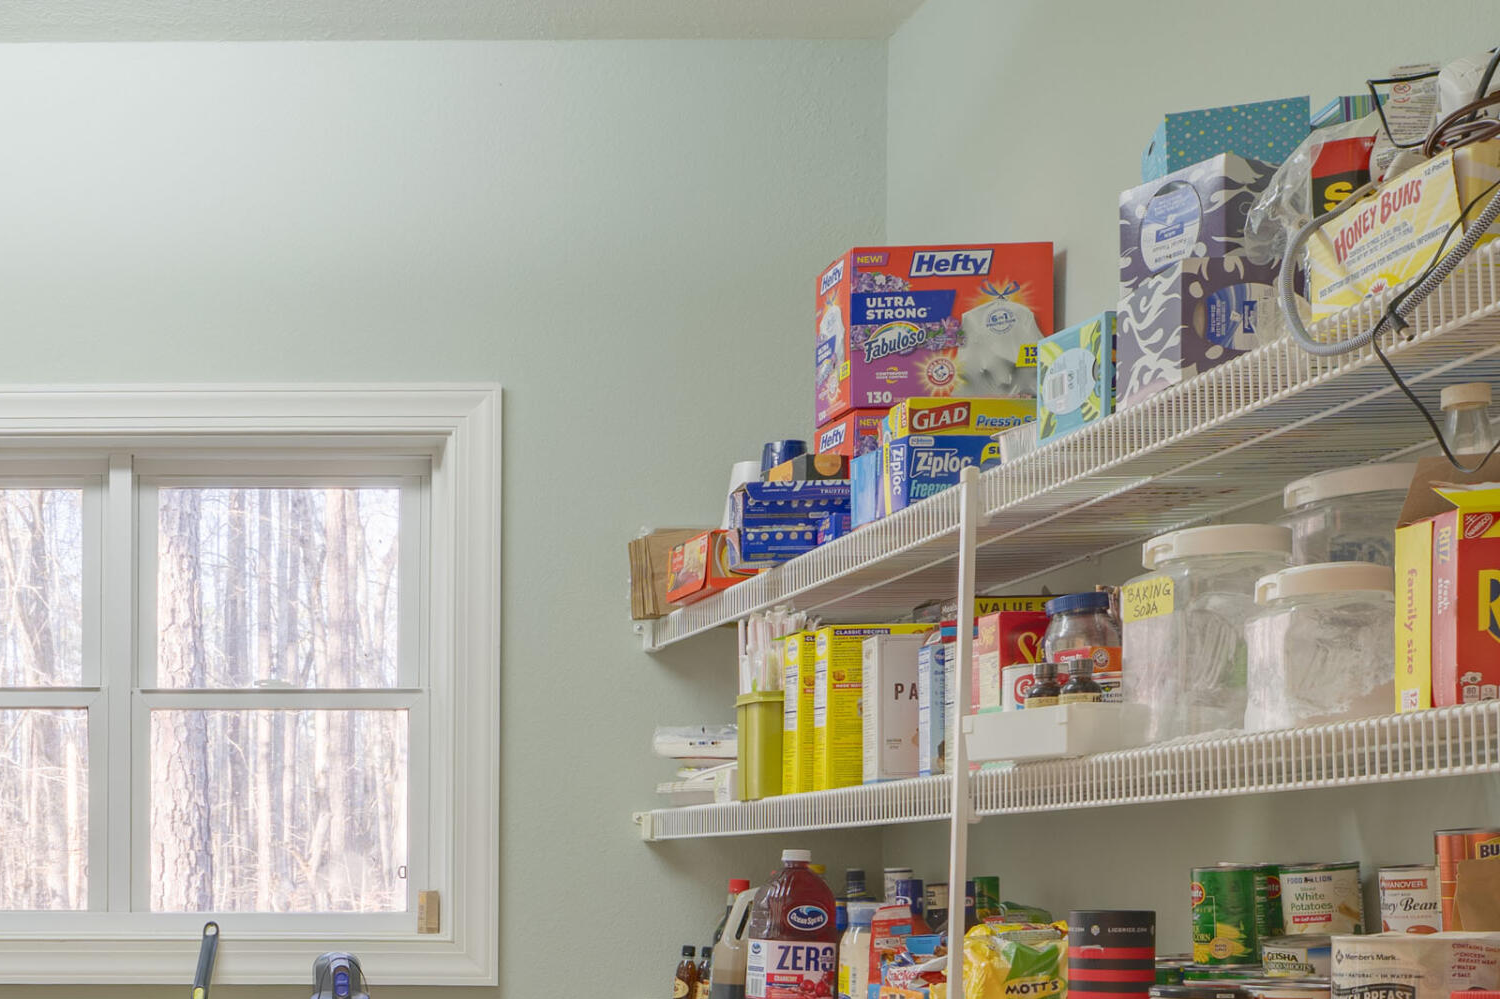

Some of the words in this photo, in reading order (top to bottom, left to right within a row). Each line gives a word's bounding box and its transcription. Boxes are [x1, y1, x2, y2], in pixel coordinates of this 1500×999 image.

[1334, 204, 1377, 265] HONEY
[1380, 179, 1422, 225] BUNS
[856, 256, 883, 264] NEW!
[914, 253, 988, 275] Hefty
[822, 267, 843, 288] Hefty
[866, 296, 915, 308] ULTRA
[866, 308, 927, 320] STRONG
[864, 329, 926, 363] Fabuloso
[1024, 346, 1038, 357] 13
[867, 391, 892, 404] 130
[912, 407, 968, 430] GLAD
[976, 415, 1021, 427] Press'n
[822, 429, 844, 450] Hefty
[891, 447, 902, 496] Ziploc
[916, 452, 972, 478] Ziploc
[910, 480, 951, 498] Freeze
[1439, 526, 1451, 564] RITZ
[1127, 583, 1171, 603] BAKING
[1404, 568, 1418, 632] family
[979, 602, 1033, 614] VALUE
[1133, 603, 1159, 618] SODA
[1407, 639, 1418, 674] size
[1287, 876, 1302, 885] FOOD
[1315, 875, 1332, 883] LION
[1382, 880, 1423, 889] HANOVER
[1295, 892, 1325, 901] White
[1291, 902, 1333, 911] Potatoes
[790, 912, 807, 924] Ocean
[807, 914, 824, 927] Spray
[776, 945, 834, 972] ZERO
[1267, 951, 1299, 962] GEISHA
[889, 968, 921, 982] racker
[1006, 981, 1059, 995] MOTT'S
